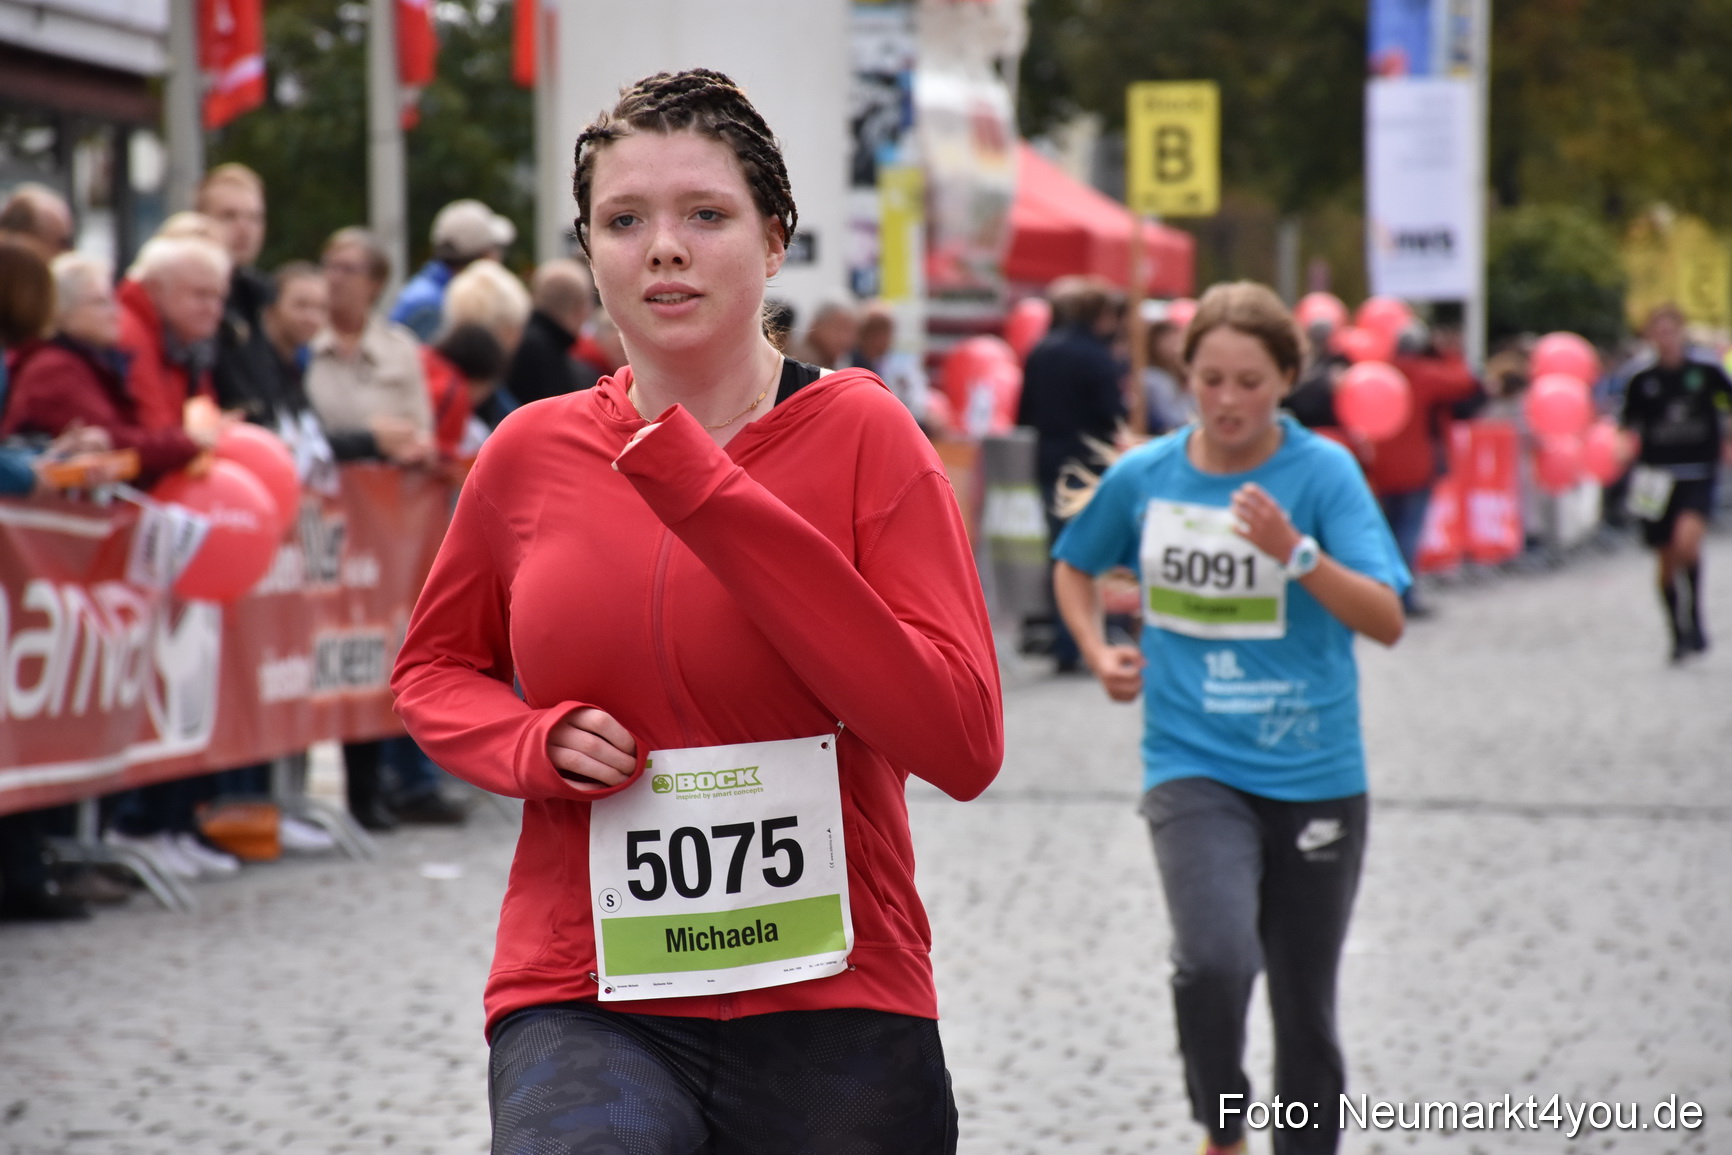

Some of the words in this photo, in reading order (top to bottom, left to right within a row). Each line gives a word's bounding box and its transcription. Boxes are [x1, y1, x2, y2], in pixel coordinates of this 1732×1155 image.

[1154, 125, 1193, 184] B
[1162, 546, 1255, 590] 5091
[675, 766, 762, 792] BOCK
[676, 793, 701, 801] inspired
[713, 790, 732, 798] smart
[734, 787, 764, 796] concepts
[627, 815, 805, 901] 5075
[606, 894, 615, 907] S
[665, 919, 779, 953] Michaela
